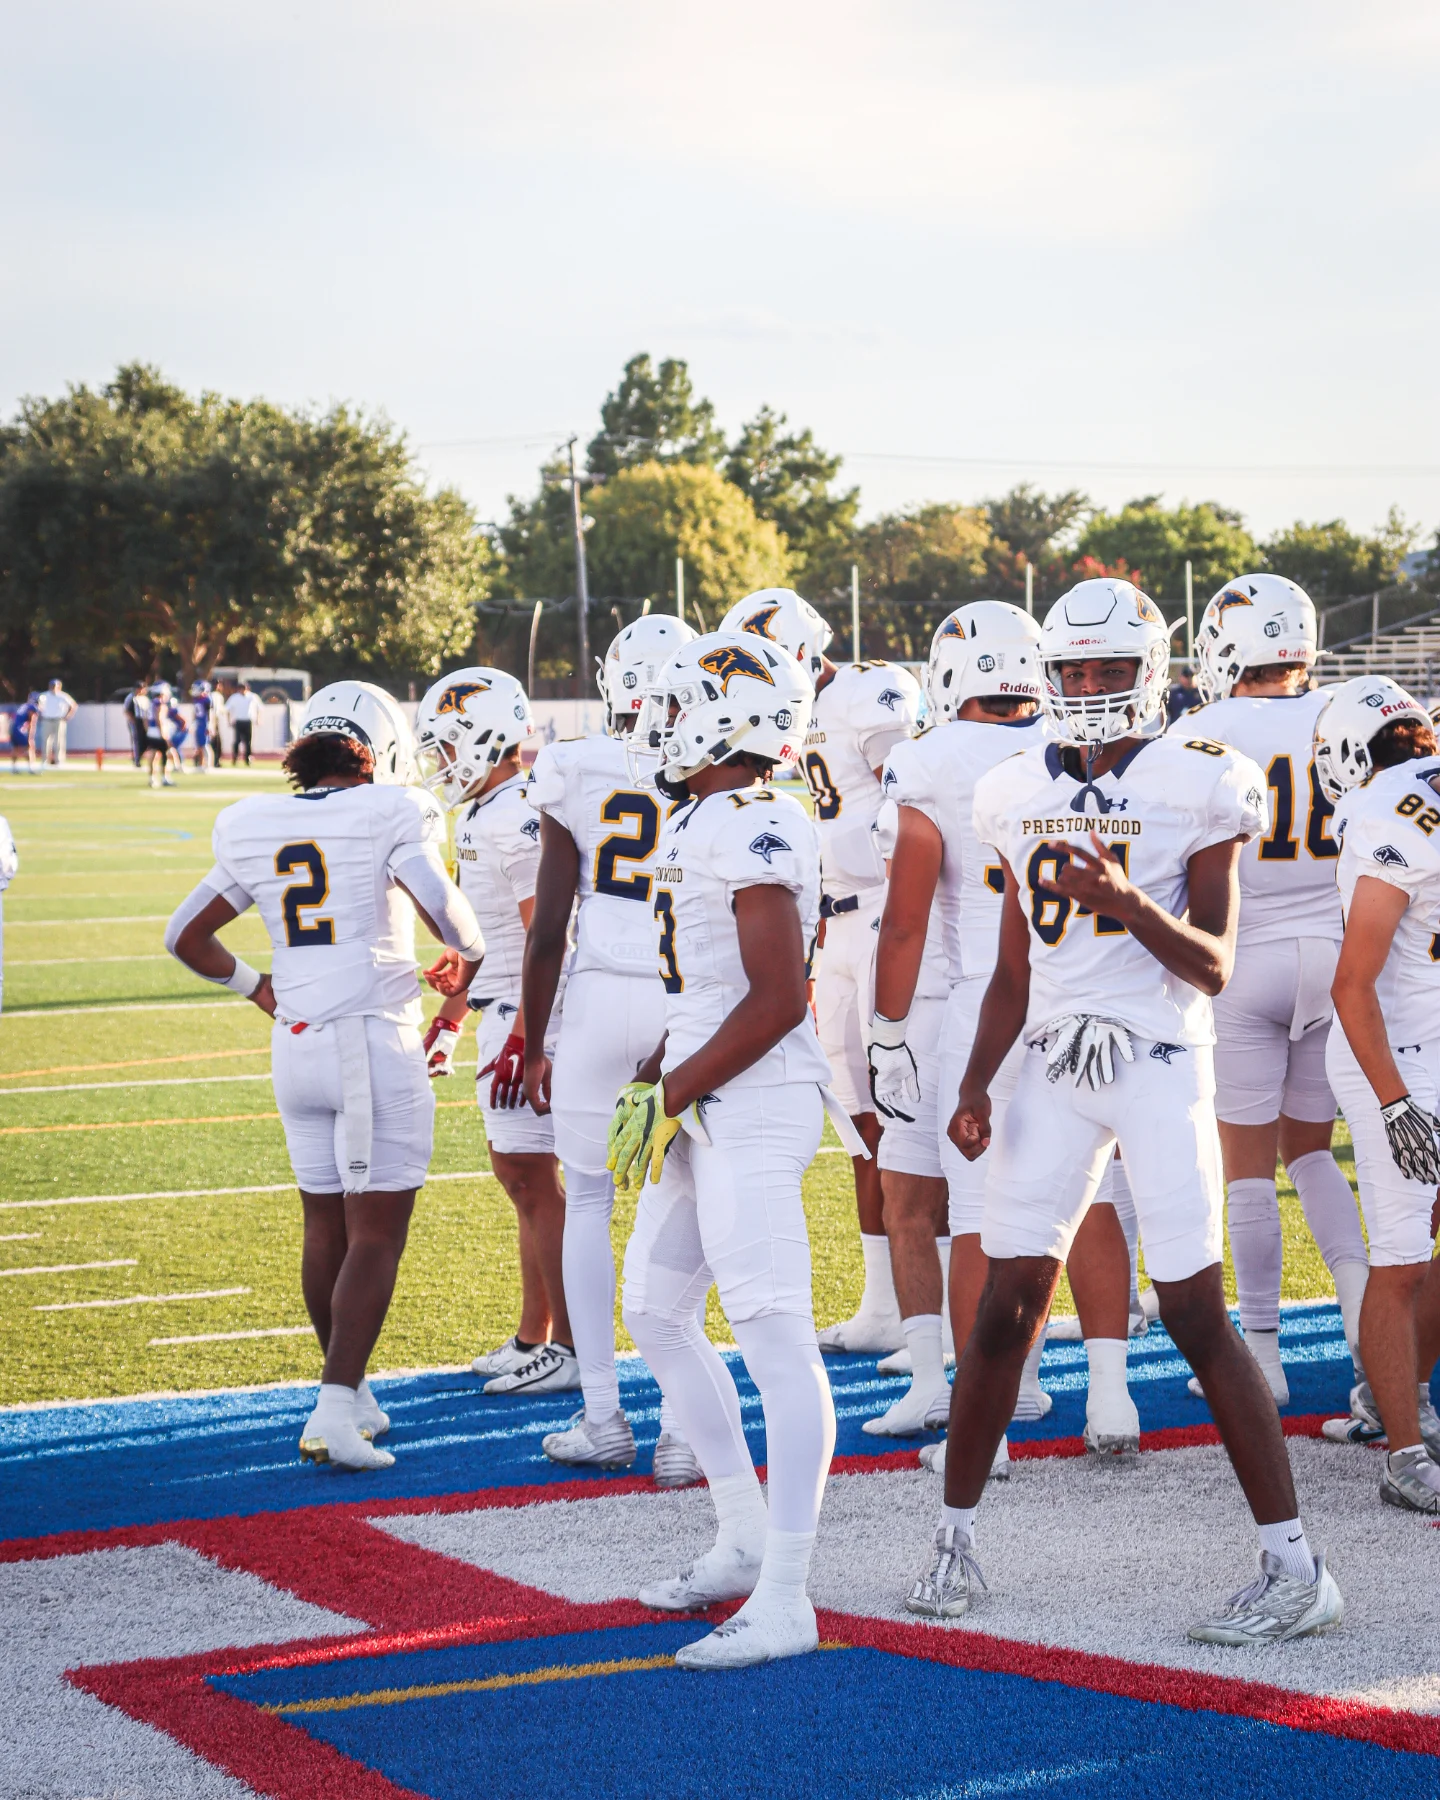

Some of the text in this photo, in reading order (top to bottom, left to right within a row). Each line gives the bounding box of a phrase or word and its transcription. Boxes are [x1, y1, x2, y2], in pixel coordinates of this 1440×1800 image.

[1265, 624, 1280, 636] BB
[979, 656, 995, 669] BB
[623, 675, 637, 688] BB
[1367, 694, 1384, 708] BB
[310, 716, 348, 728] schutt
[777, 712, 791, 727] BB
[1394, 793, 1440, 837] 82
[1022, 817, 1142, 837] PRESTONWOOD
[273, 839, 336, 948] 2
